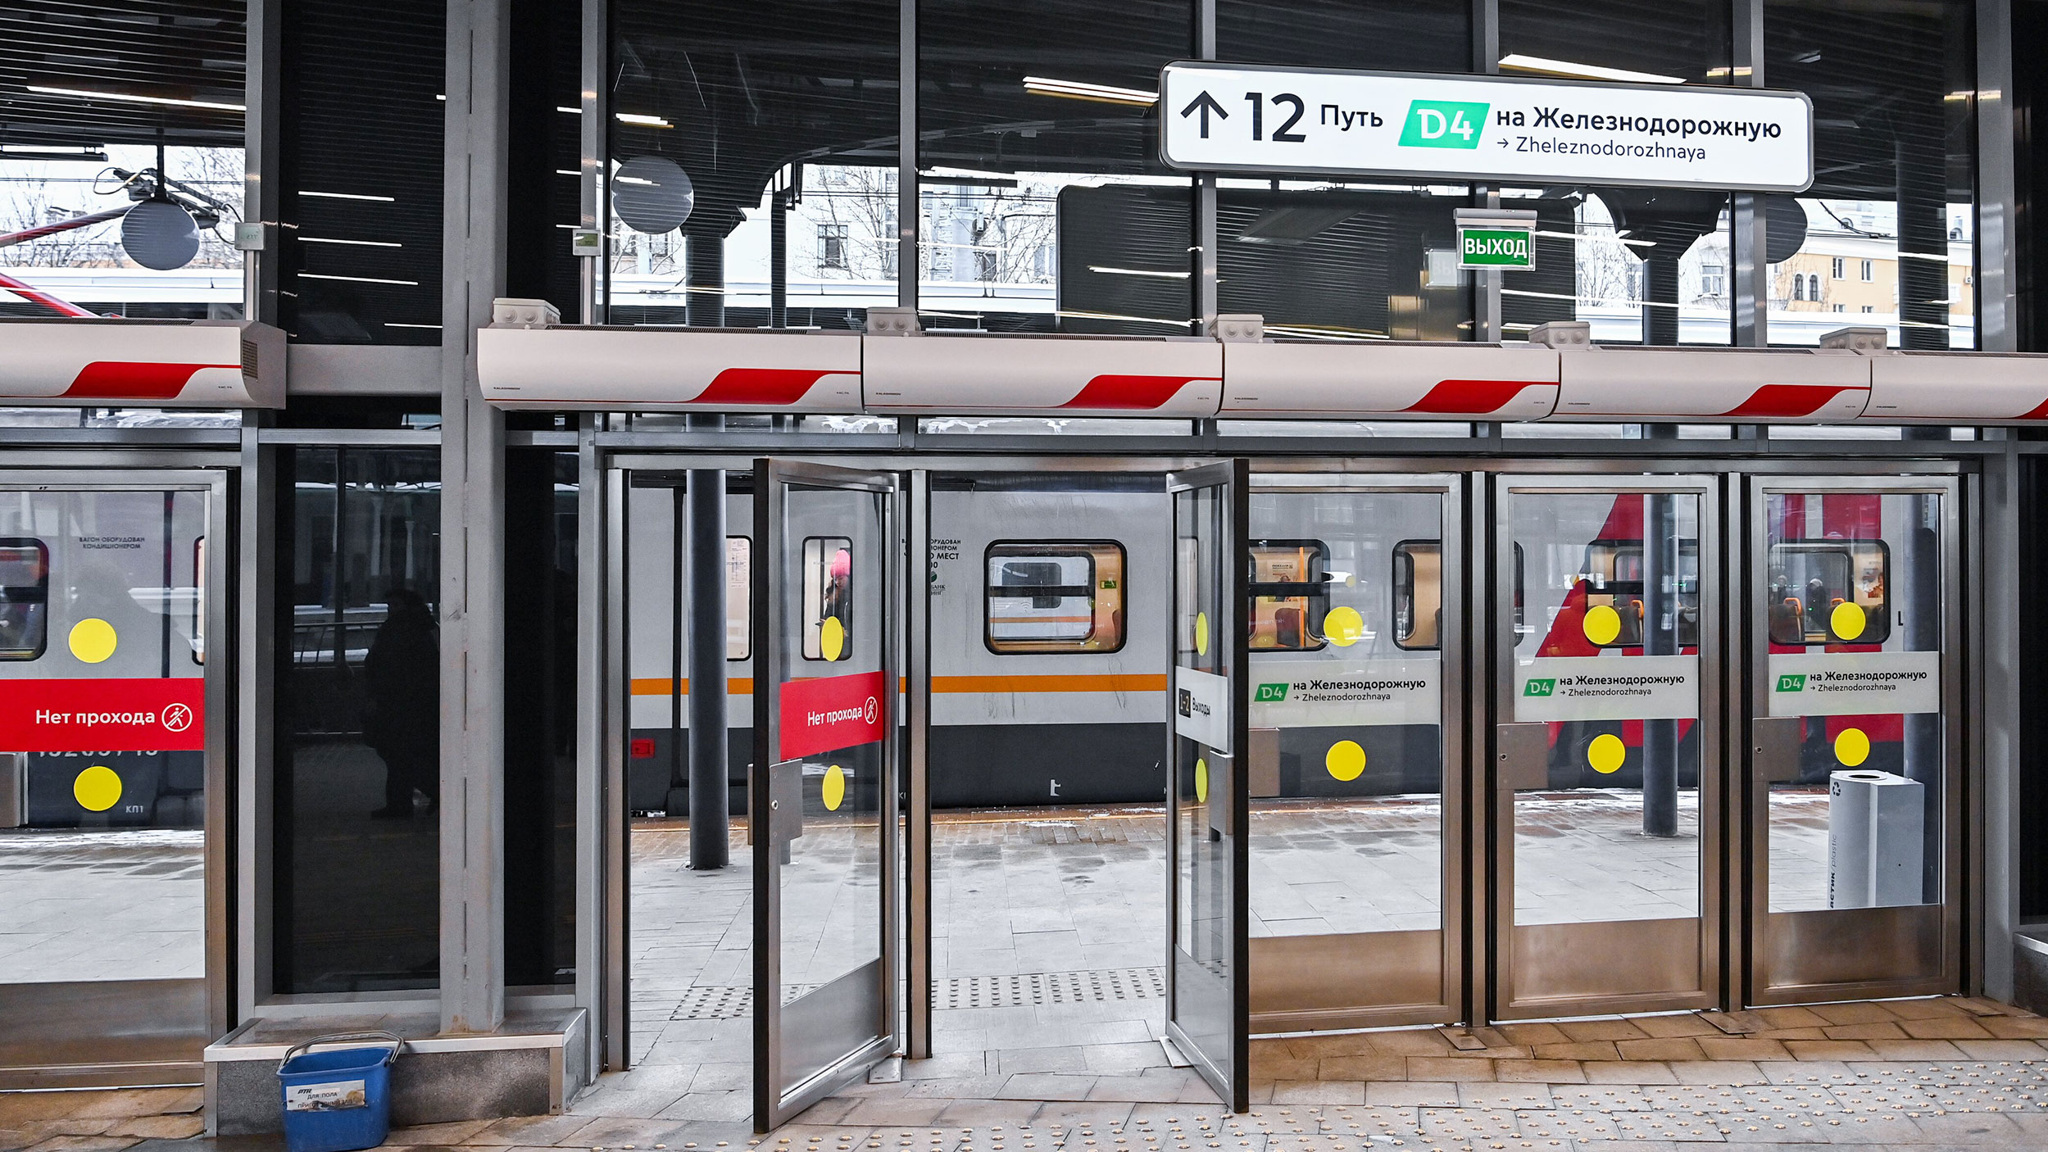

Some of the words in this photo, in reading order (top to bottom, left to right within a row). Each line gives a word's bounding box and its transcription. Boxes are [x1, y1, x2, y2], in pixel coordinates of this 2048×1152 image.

[1244, 92, 1307, 143] 12
[1320, 104, 1383, 131] Путь
[1416, 108, 1474, 141] D4
[1496, 109, 1525, 127] на
[1533, 106, 1782, 142] Железнодорожную
[1515, 136, 1706, 162] Zheleznodorozhnaya
[1464, 238, 1528, 259] ВЫХОД
[936, 552, 960, 560] МЕСТ
[1559, 677, 1573, 686] на
[1575, 675, 1685, 686] Железнодорожную
[1809, 673, 1823, 681] на
[1824, 671, 1928, 682] Железнодорожную
[1292, 681, 1307, 690] на
[1309, 679, 1427, 691] Железнодорожную
[1529, 681, 1551, 694] D4
[1781, 677, 1802, 690] D4
[1817, 683, 1897, 692] Zheleznodorozhnaya
[1261, 686, 1284, 699] D4
[1302, 692, 1391, 702] Zheleznodorozhnaya
[1568, 687, 1652, 697] Zheleznodorozhnaya
[35, 709, 72, 724] Нет
[76, 711, 156, 727] прохода
[807, 710, 825, 727] Нет
[826, 706, 863, 725] прохода
[125, 805, 144, 814] КП1
